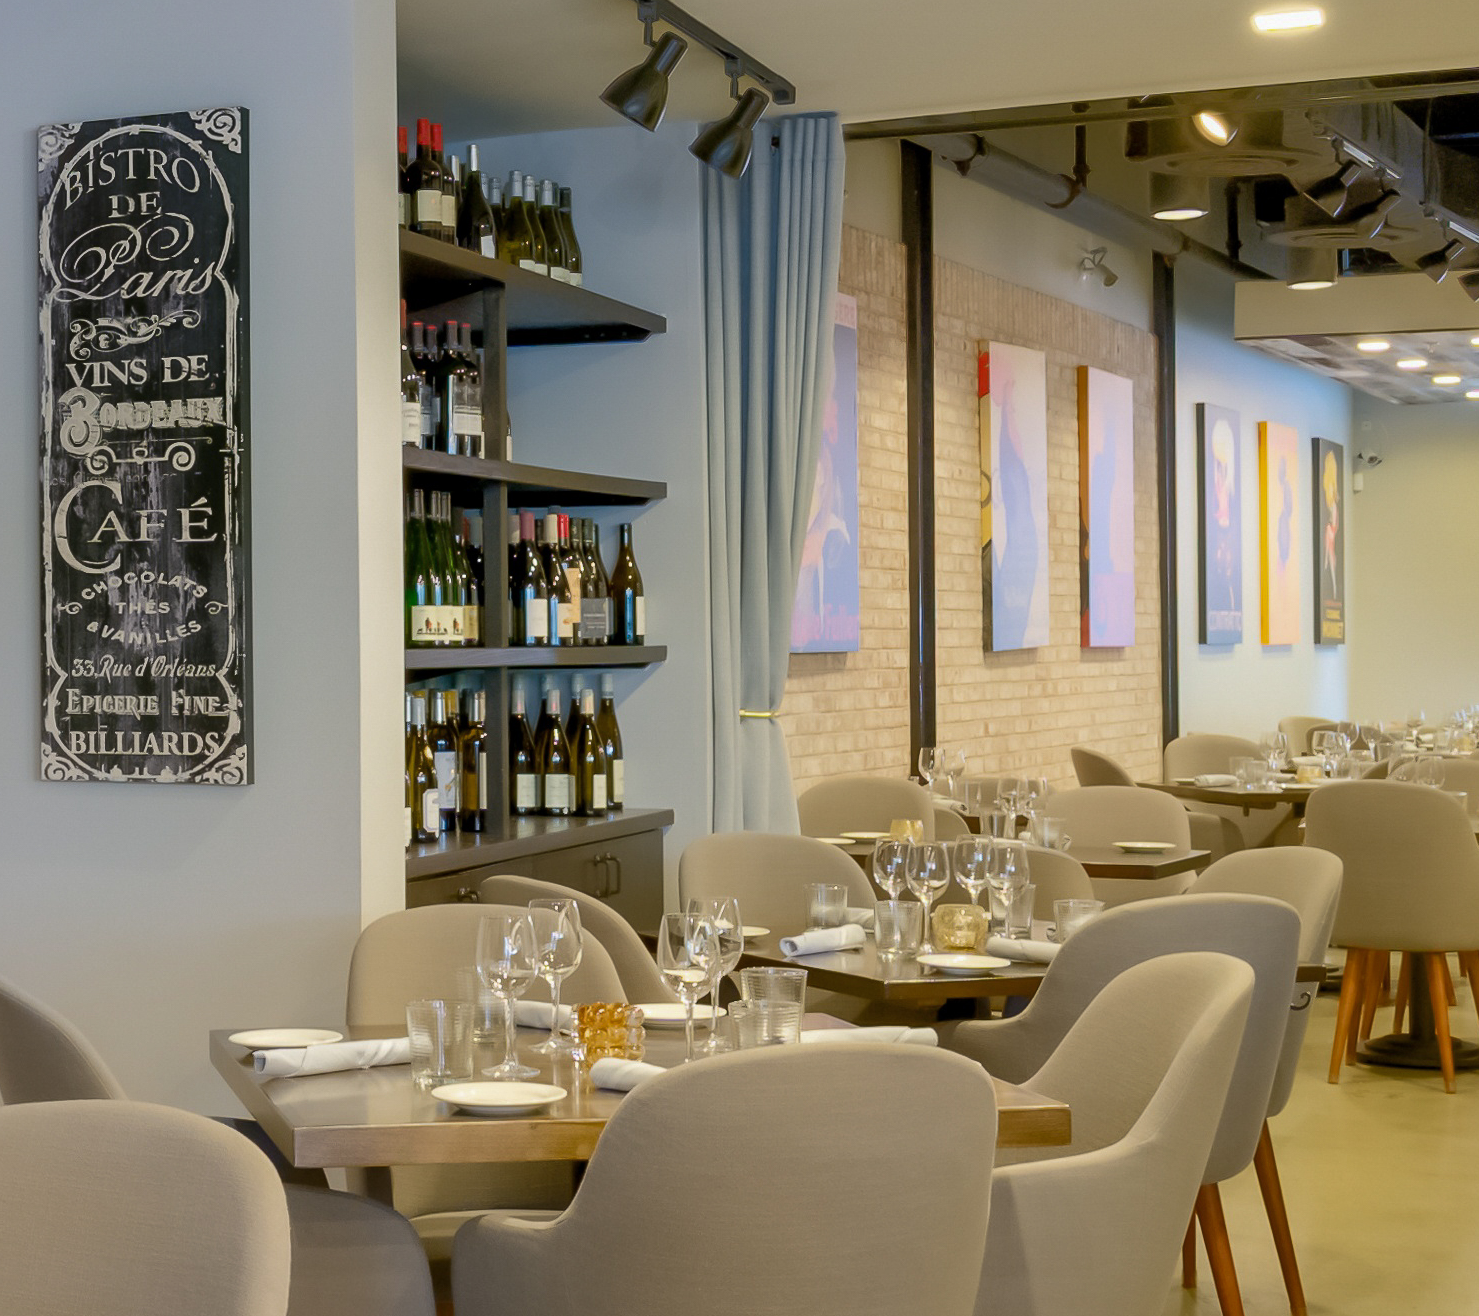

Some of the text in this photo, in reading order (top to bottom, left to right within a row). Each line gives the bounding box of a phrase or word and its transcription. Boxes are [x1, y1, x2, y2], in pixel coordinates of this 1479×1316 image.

[64, 148, 200, 211] BISTRO
[108, 191, 162, 218] DE
[55, 212, 216, 302] Paris
[65, 354, 210, 388] VINS DE
[57, 386, 227, 460] BORDEAUX
[53, 480, 218, 575] CAFÉ
[81, 571, 208, 600] CHOCOLATS
[101, 619, 202, 645] VANILLES
[97, 654, 131, 684] Rue
[135, 655, 216, 678] d'Orléans
[65, 688, 226, 721] EPICERIE FINE
[69, 730, 220, 756] BILLIARDS
